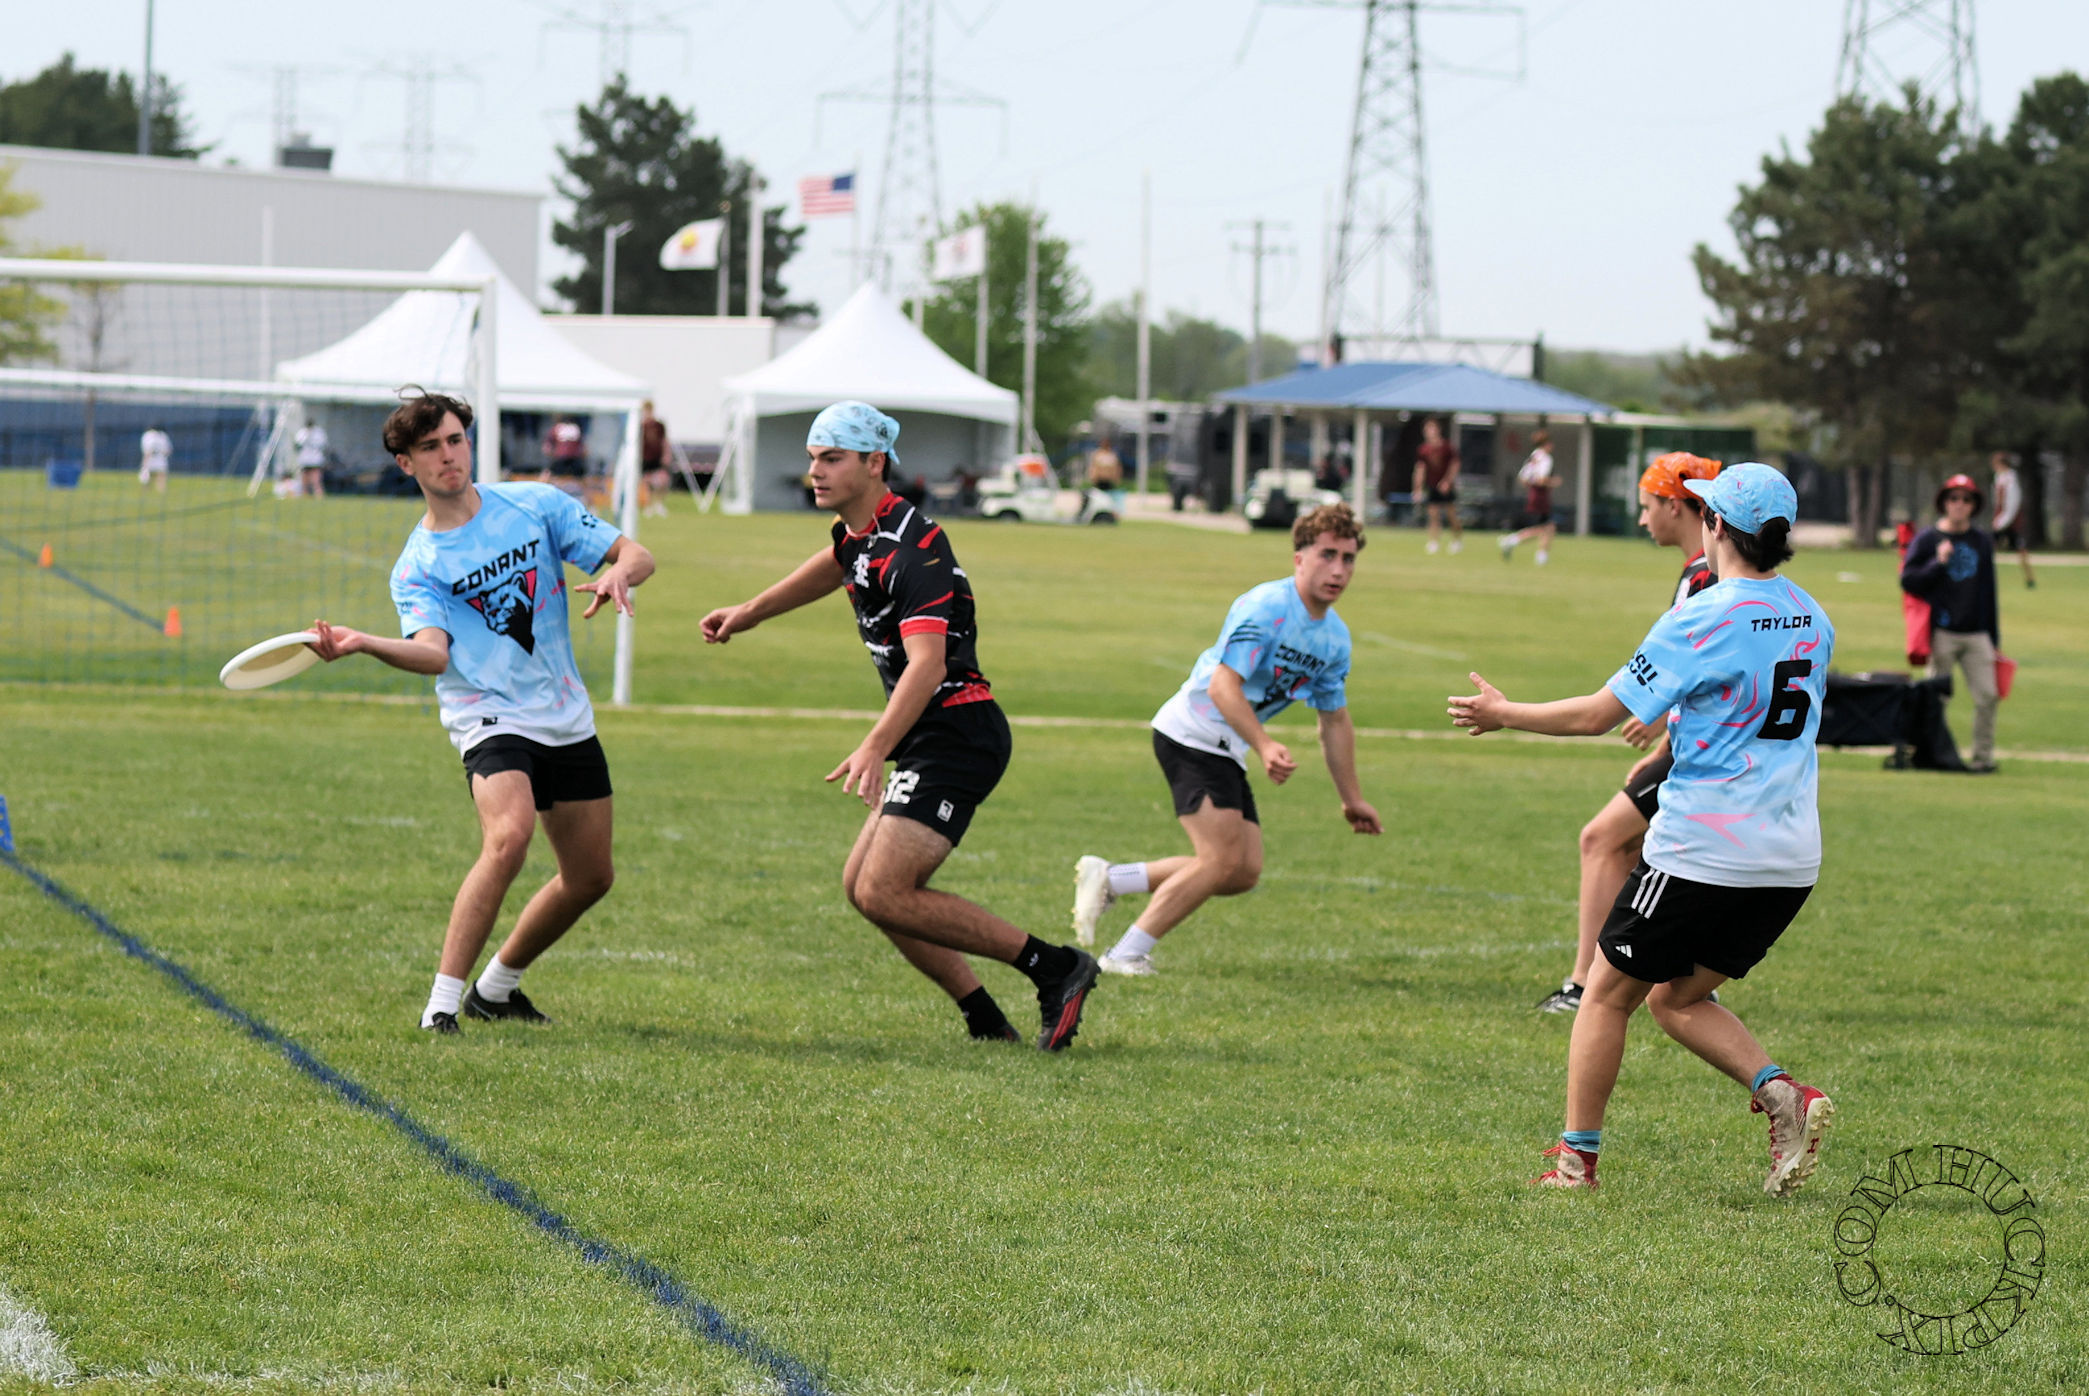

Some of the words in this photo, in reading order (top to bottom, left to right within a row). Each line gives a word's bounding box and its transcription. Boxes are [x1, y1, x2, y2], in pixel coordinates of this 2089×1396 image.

[451, 539, 540, 597] CONANT
[1751, 615, 1812, 632] TAYLOR
[1756, 659, 1812, 740] 6
